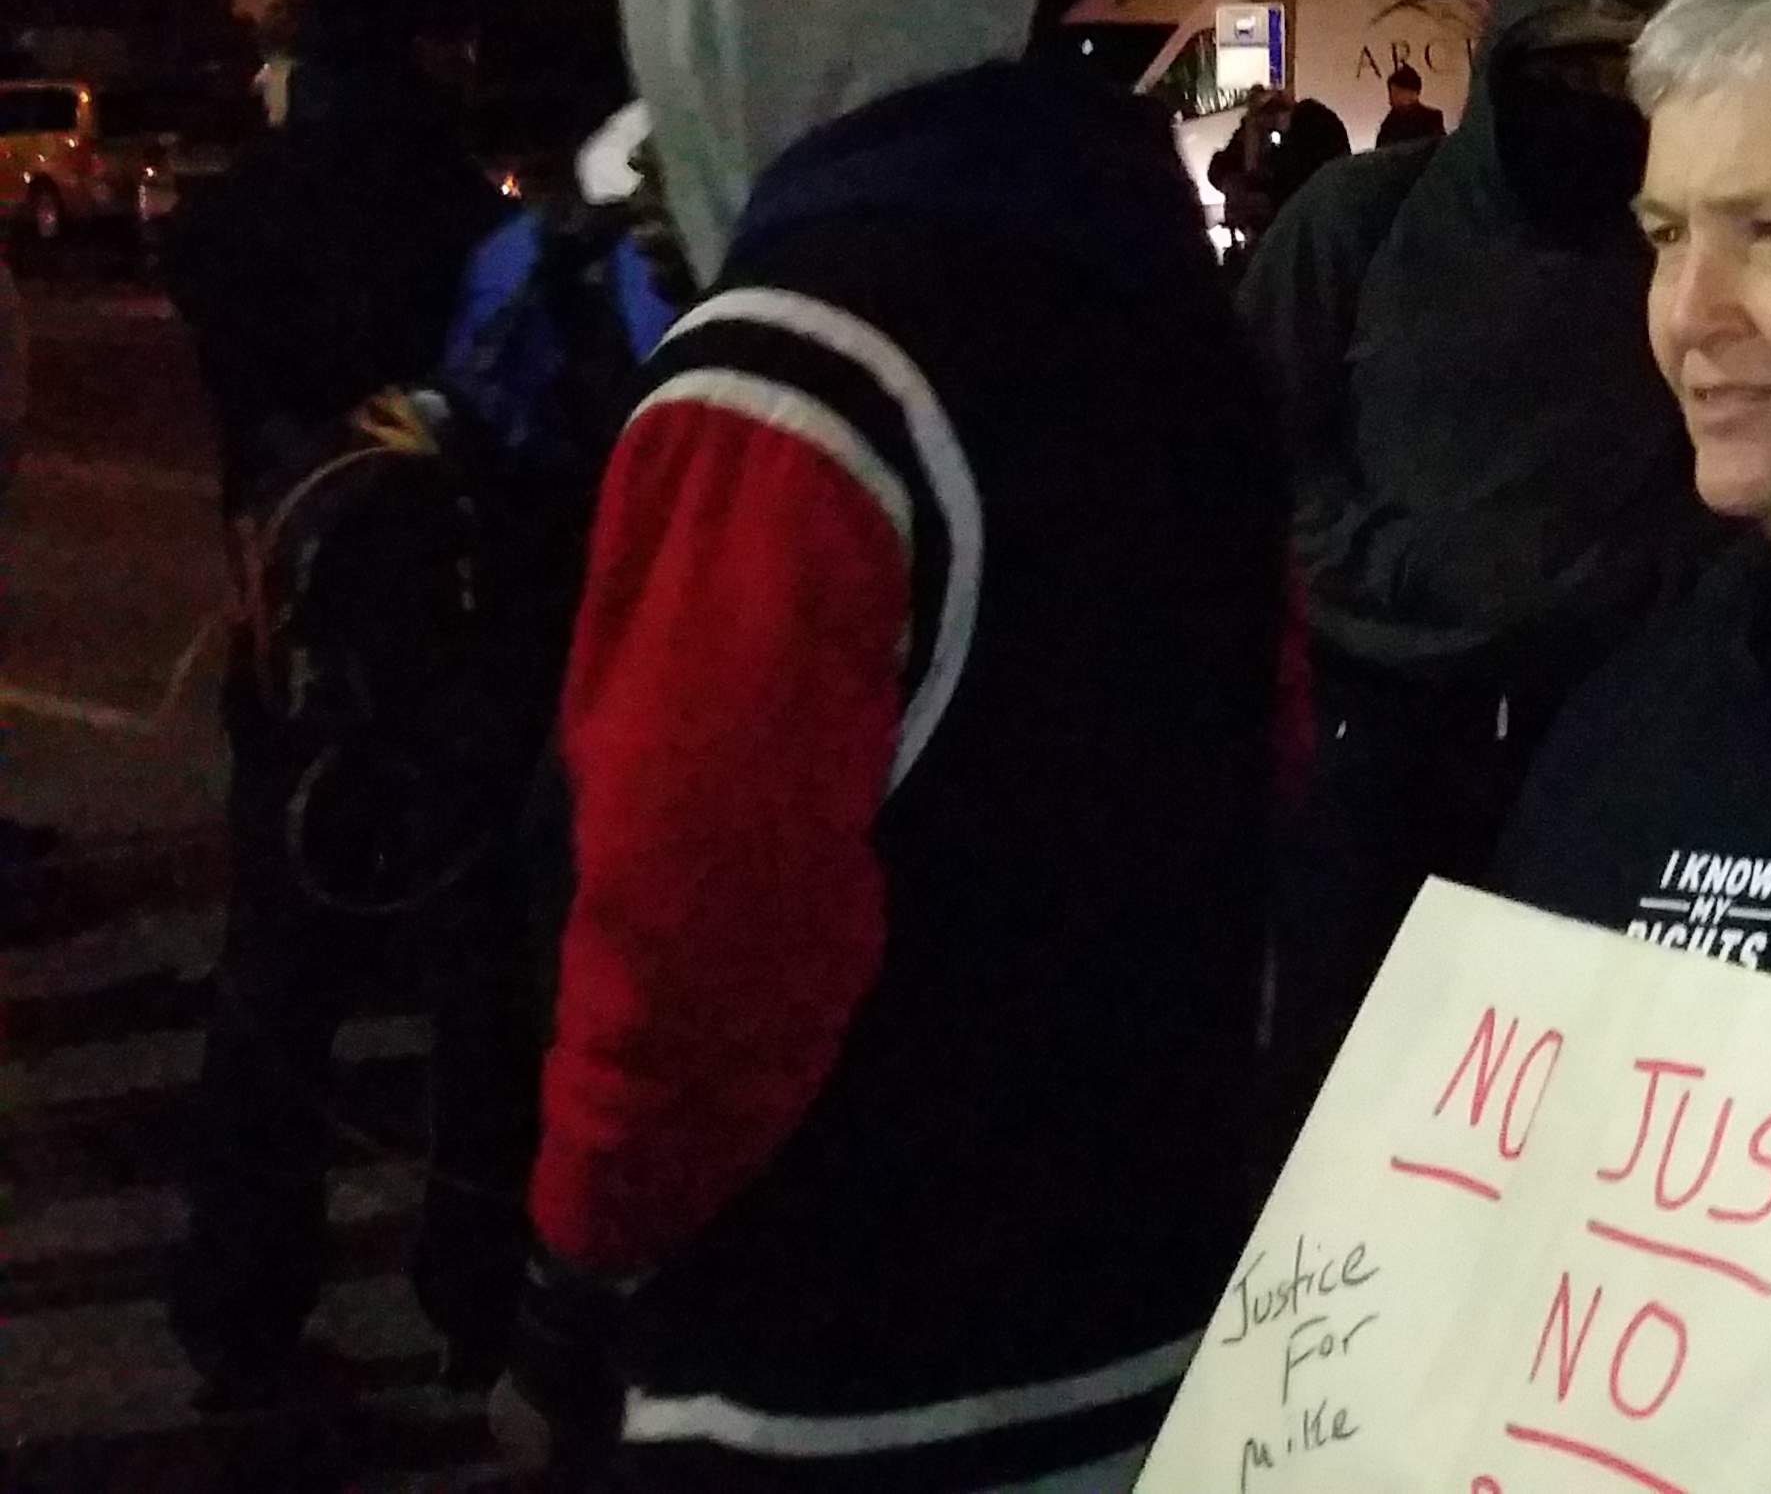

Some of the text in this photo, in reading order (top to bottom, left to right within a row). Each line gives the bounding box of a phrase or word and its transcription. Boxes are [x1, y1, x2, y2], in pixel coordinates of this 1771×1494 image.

[1660, 849, 1680, 890] I
[1689, 894, 1733, 925] MY
[1435, 1007, 1563, 1158] NO
[1222, 1235, 1380, 1345] Justice
[1529, 1272, 1688, 1418] NO
